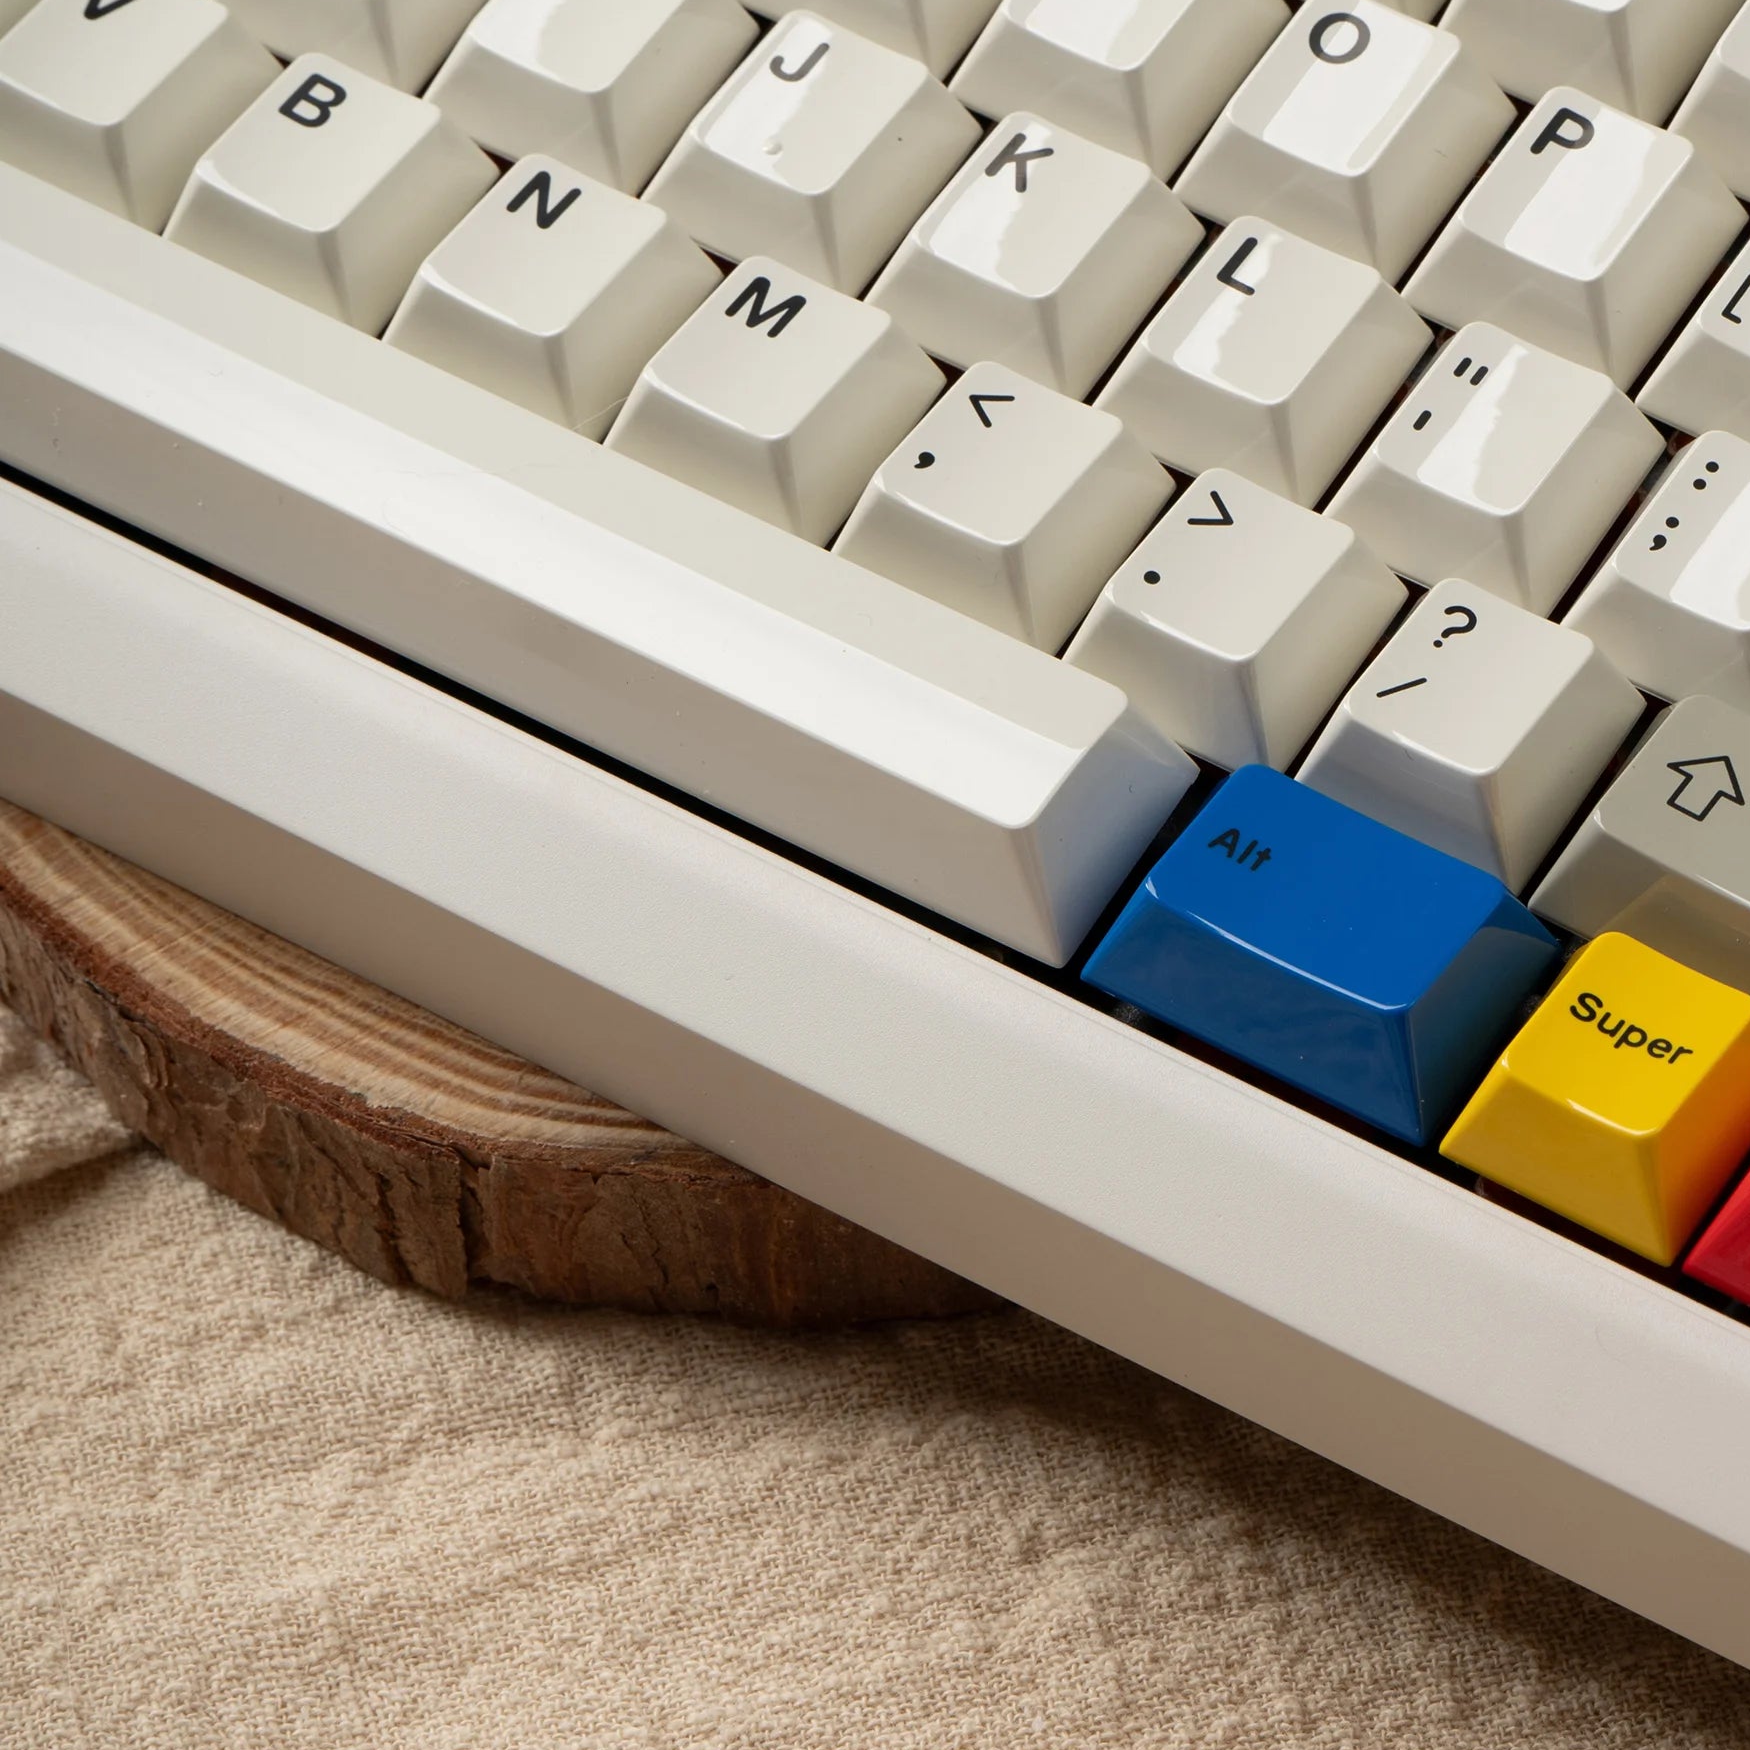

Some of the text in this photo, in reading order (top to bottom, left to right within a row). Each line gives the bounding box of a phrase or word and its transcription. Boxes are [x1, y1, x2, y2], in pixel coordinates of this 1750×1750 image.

[1309, 13, 1370, 64] O
[770, 43, 830, 82] J
[279, 74, 346, 127] B
[1530, 108, 1594, 154] P
[985, 133, 1054, 192] K
[506, 171, 581, 229] N
[1217, 237, 1258, 296] L
[725, 276, 807, 338] M
[969, 395, 1015, 428] <
[1693, 462, 1719, 490] :
[1187, 490, 1233, 525] >
[1650, 517, 1679, 550] ;
[1144, 571, 1160, 584] .
[1433, 606, 1477, 648] ?
[1377, 678, 1427, 698] /
[1208, 828, 1271, 871] Alt
[1570, 993, 1693, 1064] Super
